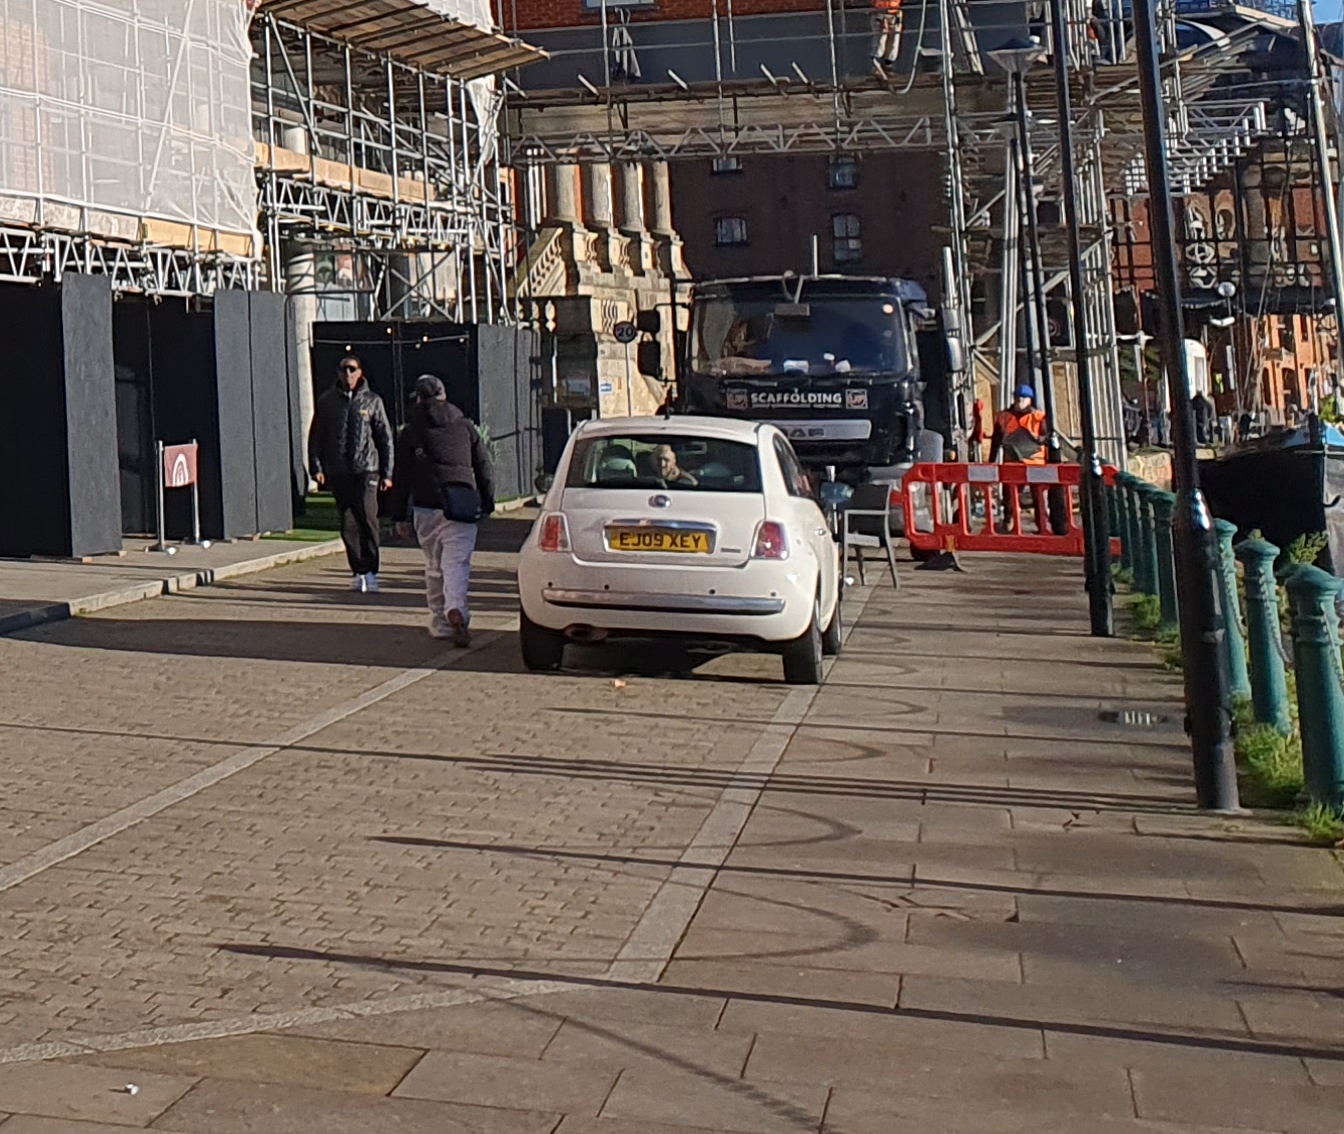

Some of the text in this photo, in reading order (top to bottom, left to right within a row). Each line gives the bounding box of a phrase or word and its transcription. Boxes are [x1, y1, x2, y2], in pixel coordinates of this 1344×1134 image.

[617, 327, 633, 337] 20
[750, 393, 842, 403] SCAFFOLDING
[619, 532, 702, 548] EJ09 XEY
